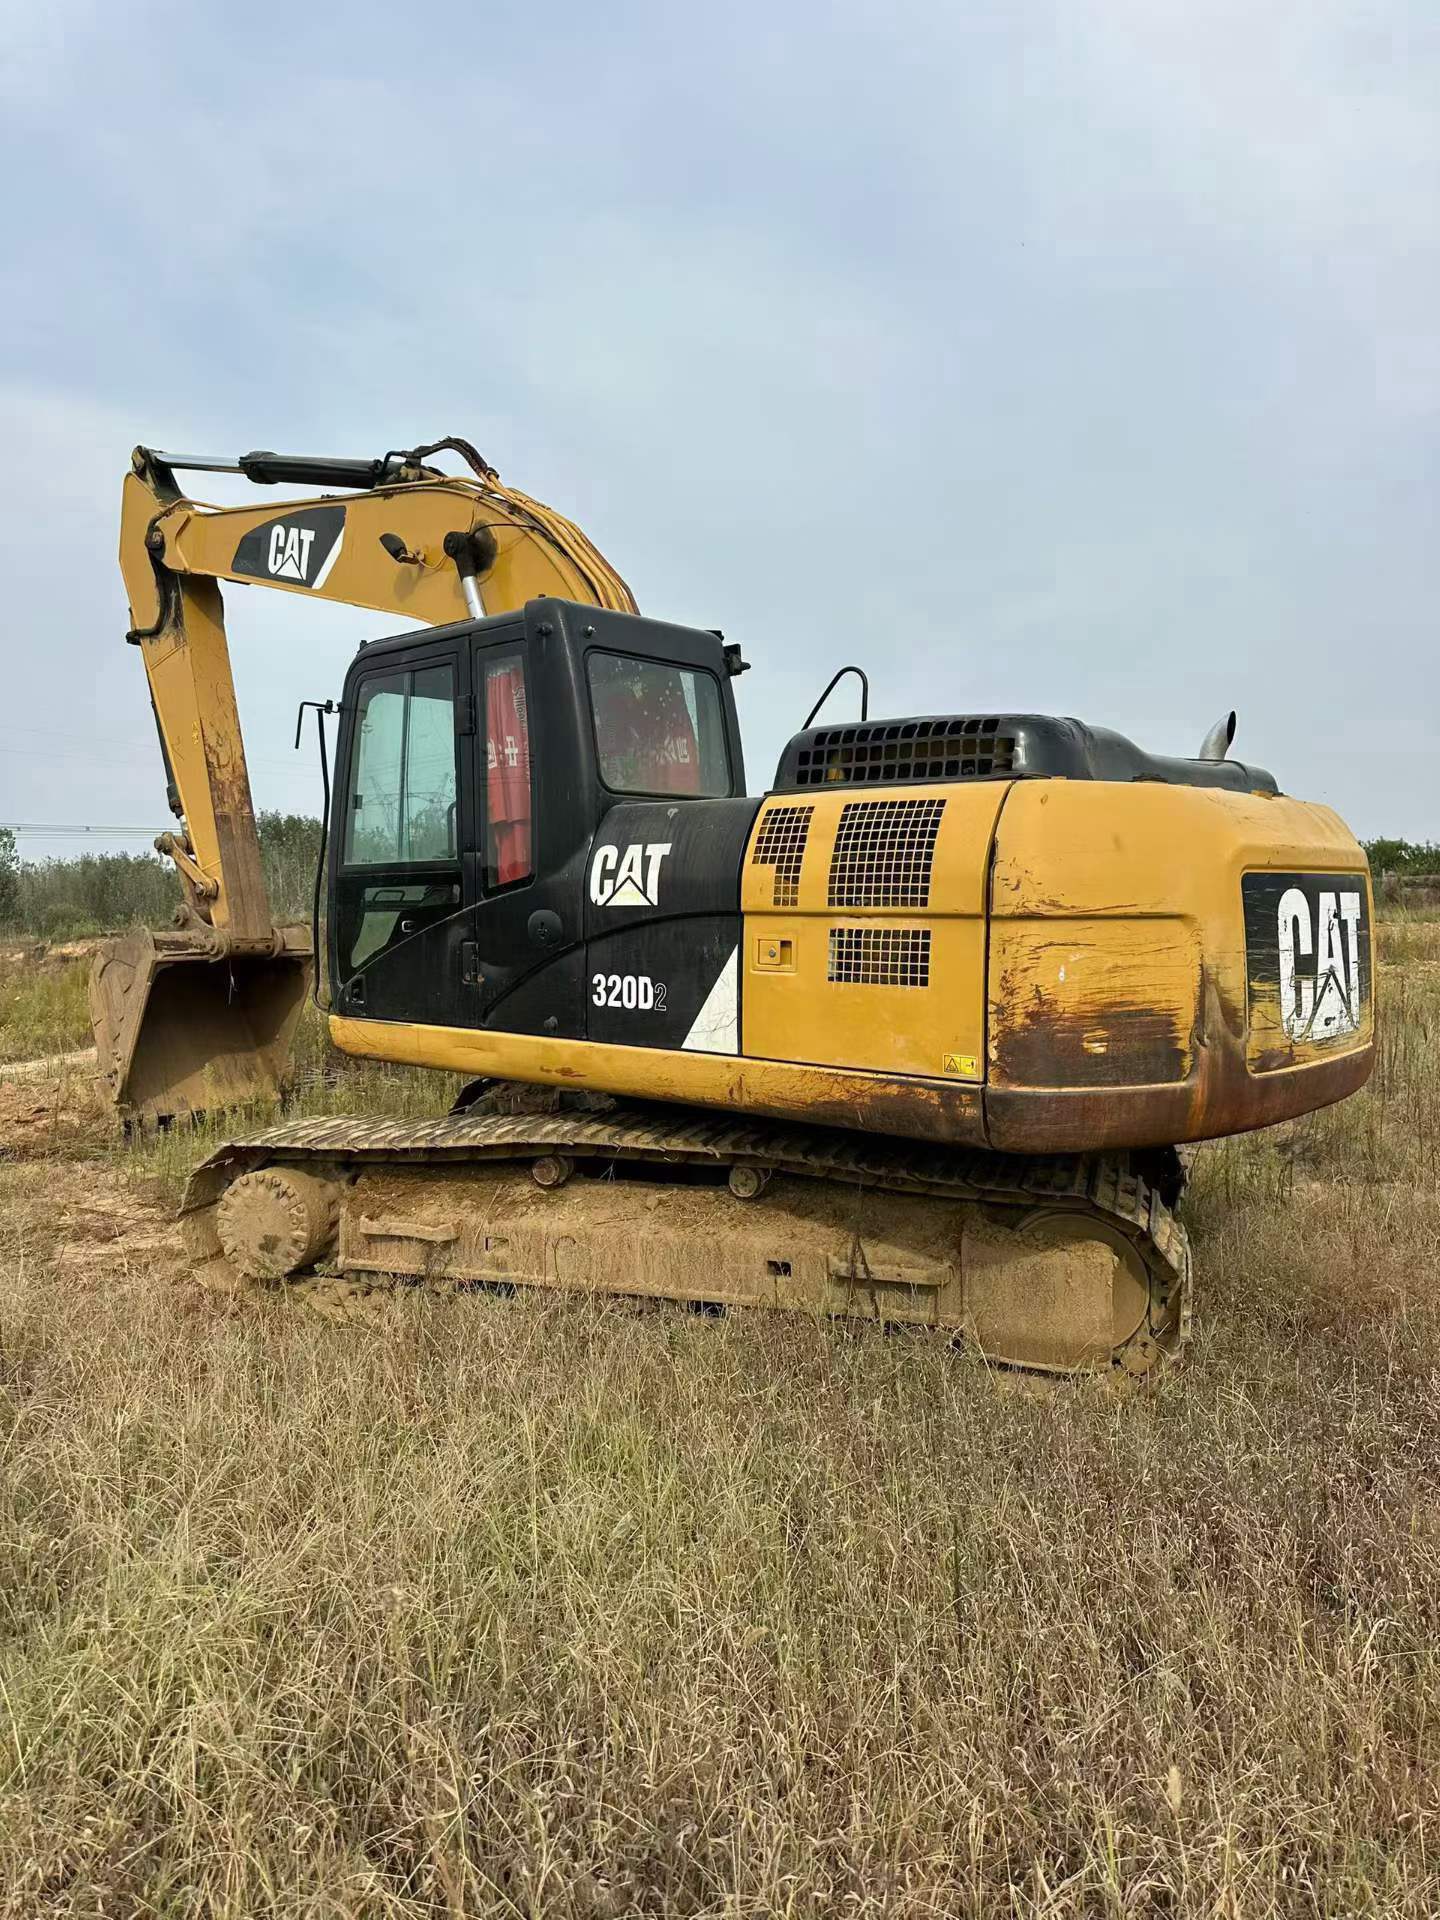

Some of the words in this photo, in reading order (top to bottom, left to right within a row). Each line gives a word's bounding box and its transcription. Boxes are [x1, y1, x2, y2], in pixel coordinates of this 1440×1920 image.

[268, 524, 315, 580] CAT
[590, 843, 672, 906] CAT
[592, 974, 667, 1011] 320D2
[1278, 888, 1361, 1044] CAT
